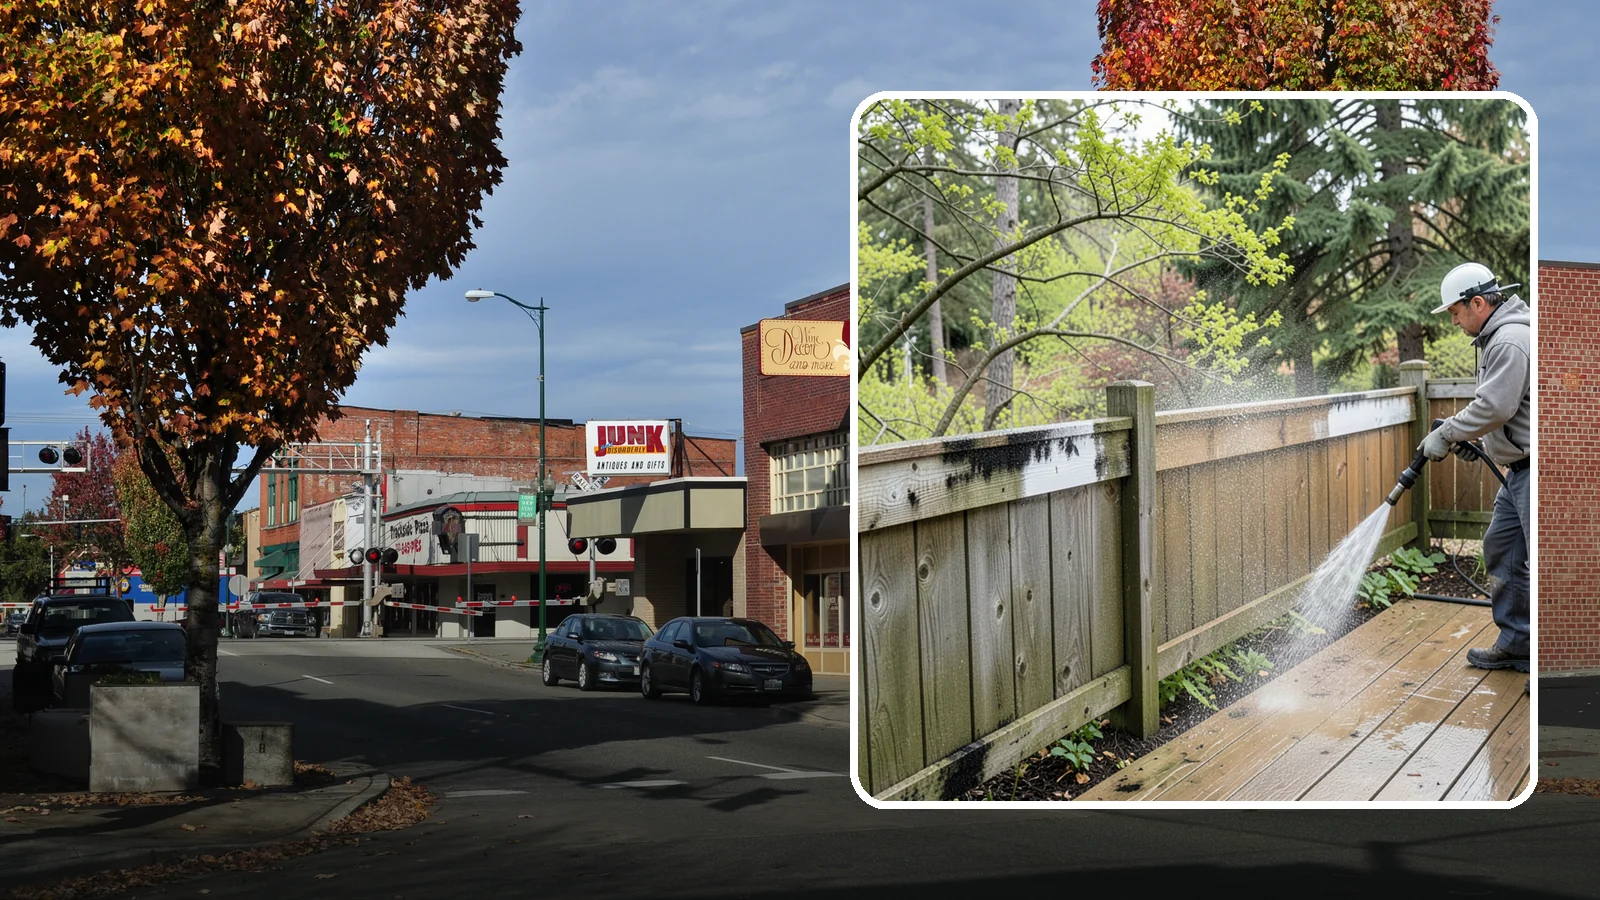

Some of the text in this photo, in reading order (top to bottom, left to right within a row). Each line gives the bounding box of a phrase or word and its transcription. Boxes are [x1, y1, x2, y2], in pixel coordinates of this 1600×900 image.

[596, 425, 664, 457] JUNK
[607, 446, 646, 454] DISORDERLY
[597, 460, 665, 470] ANTIQUES AND GIFTS
[414, 519, 429, 535] Pizza
